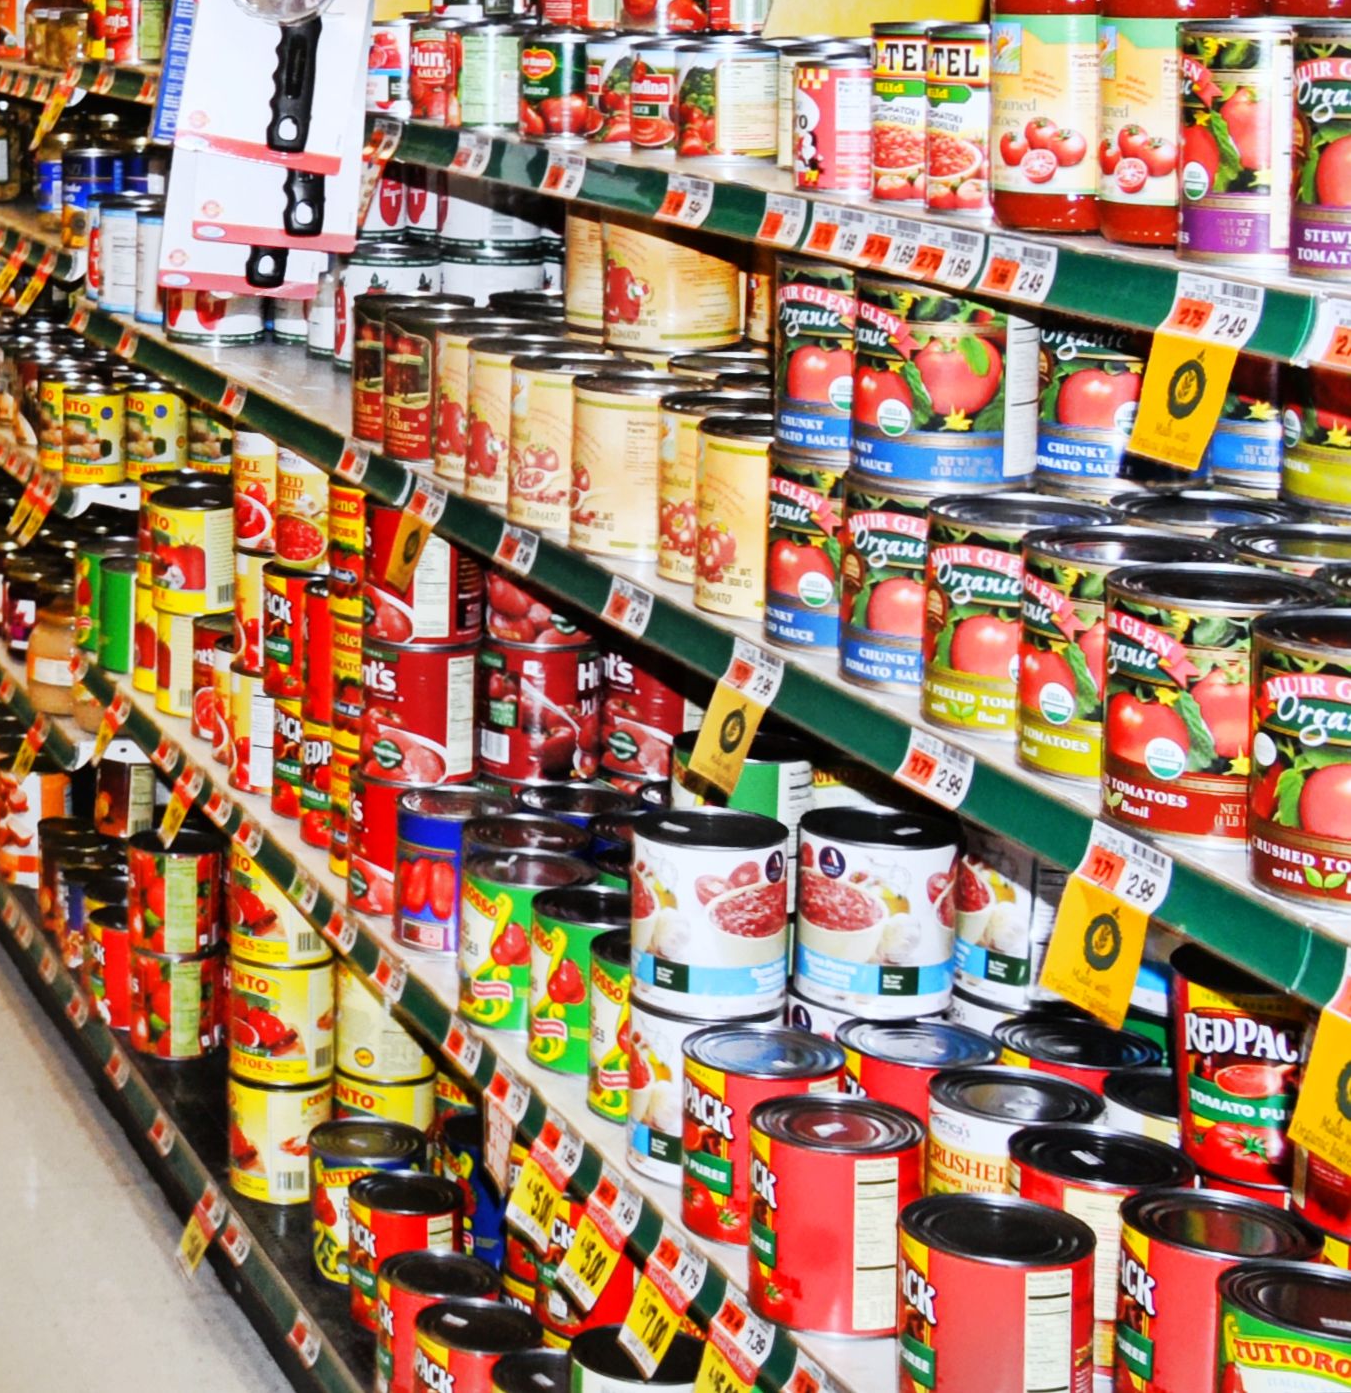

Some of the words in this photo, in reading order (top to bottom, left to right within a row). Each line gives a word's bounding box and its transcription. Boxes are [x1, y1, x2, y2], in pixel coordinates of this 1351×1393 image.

[861, 302, 900, 335] GLEN
[780, 414, 824, 431] CHUNKY
[805, 432, 848, 449] SAUCE
[1047, 441, 1108, 460] CHUNKY
[860, 457, 894, 473] SAUCE
[779, 482, 822, 512] GLEN
[935, 560, 1023, 605] Organic
[1024, 573, 1064, 610] GLEN
[778, 625, 816, 643] SAUCE
[1119, 615, 1174, 657] GLEN
[845, 657, 892, 680] TOMATO
[858, 646, 917, 667] CHUNKY
[932, 685, 976, 705] PEELED
[1265, 675, 1328, 703] MUIR
[1023, 725, 1091, 754] TOMATOES
[1111, 777, 1188, 809] TOMATOES
[1120, 798, 1150, 819] Basil
[1251, 835, 1318, 869] CRUSHED
[1272, 866, 1304, 884] with
[684, 1076, 735, 1141] PACK
[1189, 1087, 1255, 1118] TOMATO
[689, 1157, 728, 1184] PUREE
